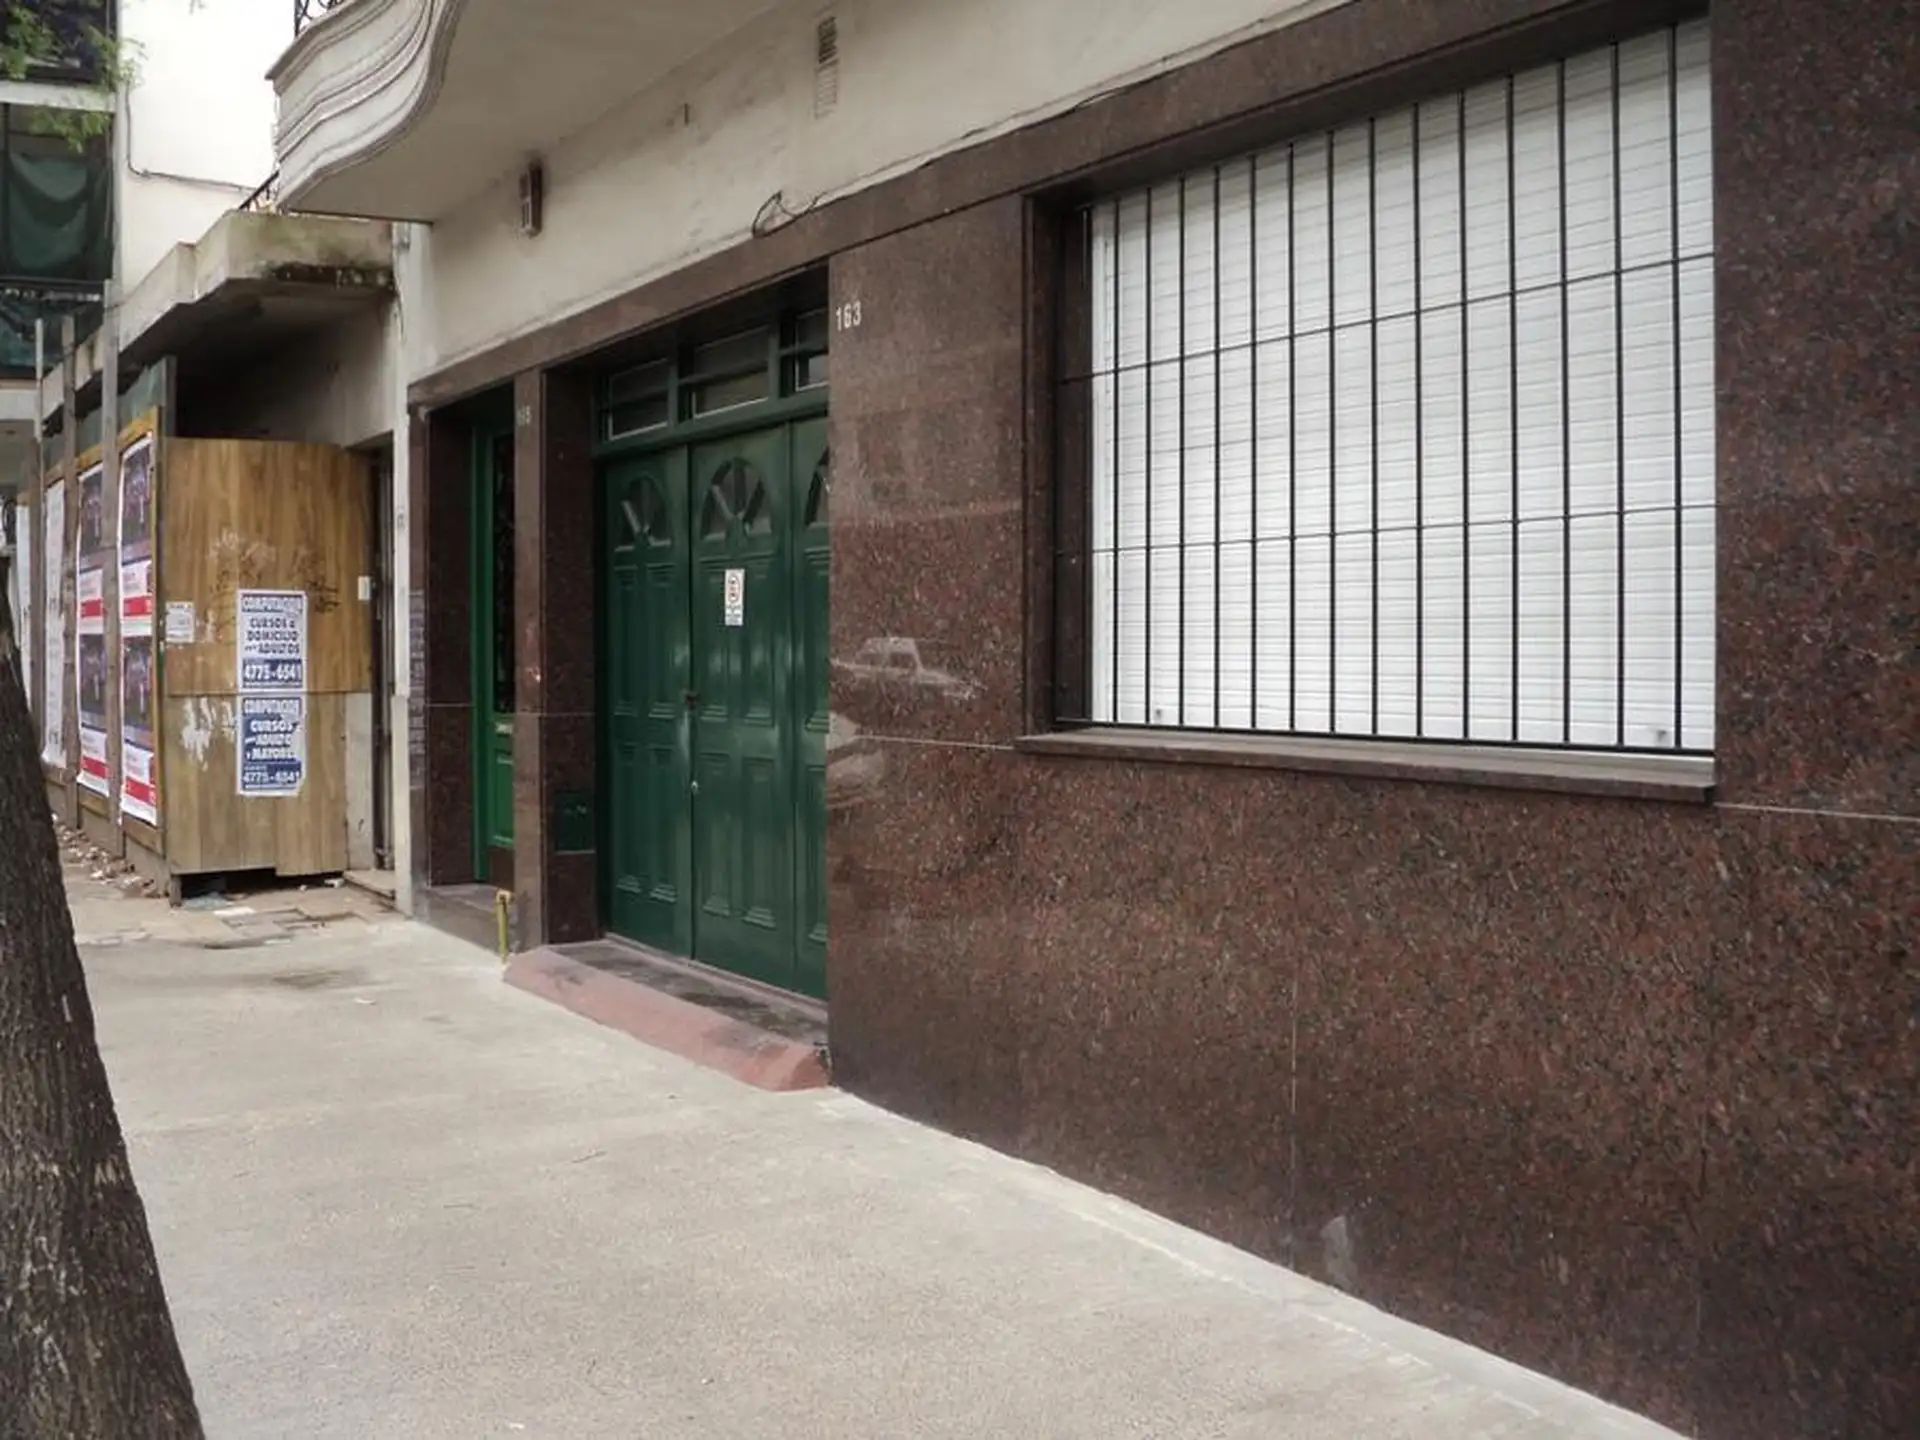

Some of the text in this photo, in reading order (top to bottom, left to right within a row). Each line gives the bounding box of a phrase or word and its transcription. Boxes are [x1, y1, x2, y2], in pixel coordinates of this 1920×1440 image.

[835, 300, 861, 331] 163
[249, 618, 287, 628] CURSOS
[247, 630, 298, 641] DOMICILIO
